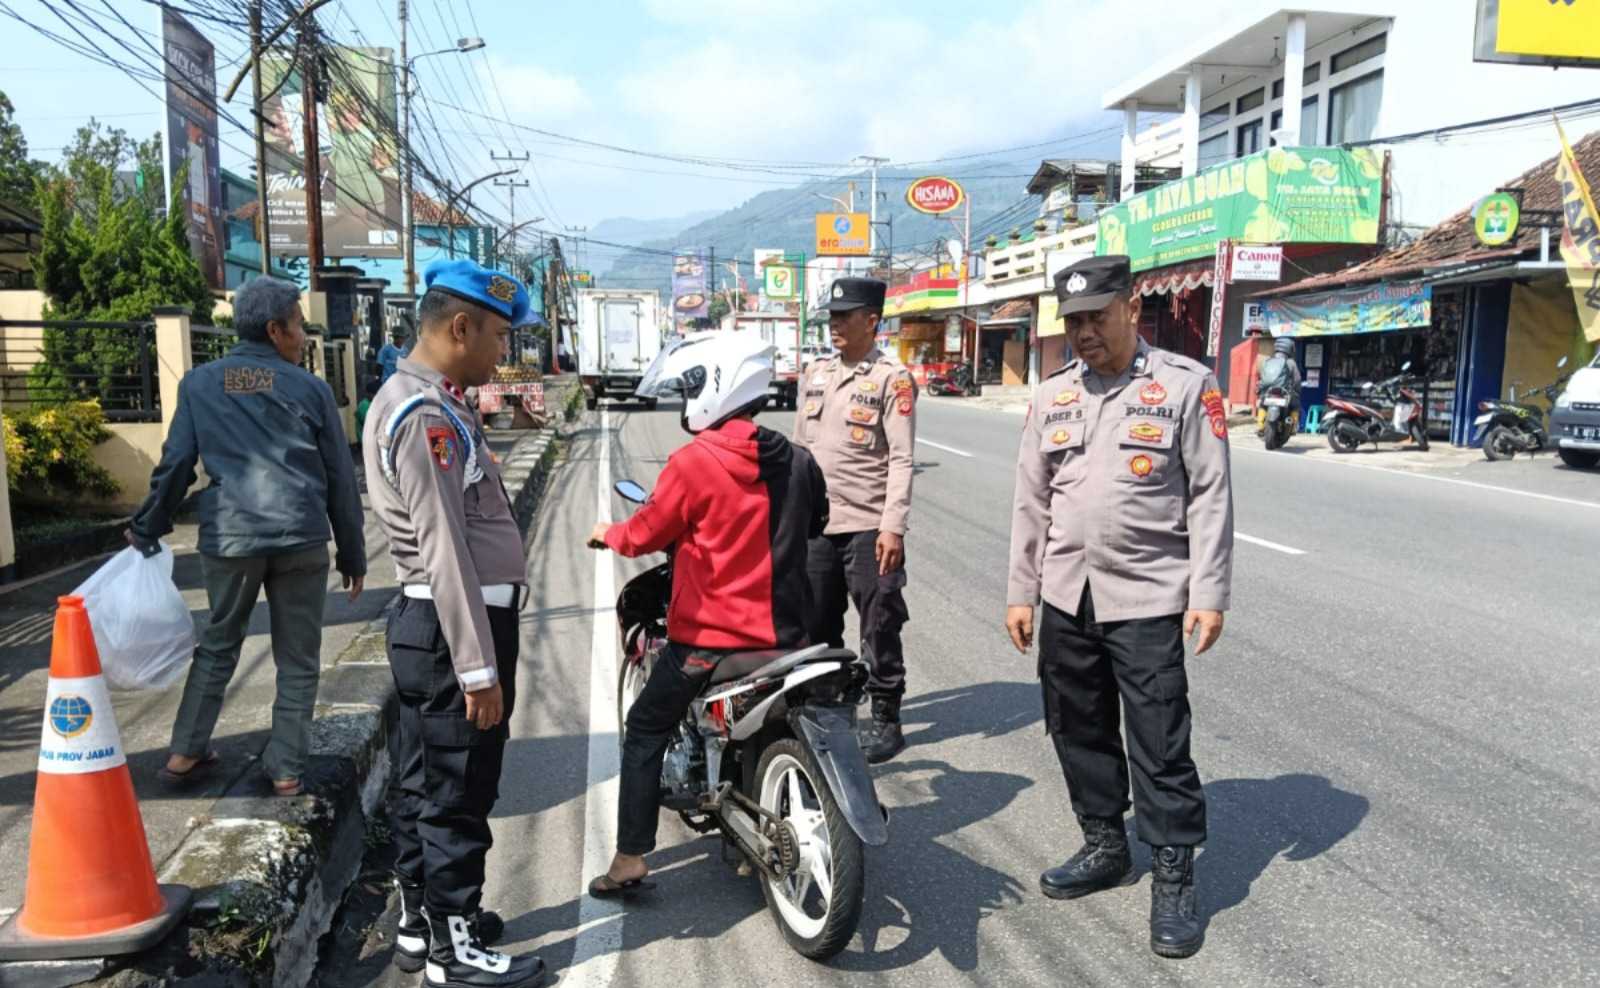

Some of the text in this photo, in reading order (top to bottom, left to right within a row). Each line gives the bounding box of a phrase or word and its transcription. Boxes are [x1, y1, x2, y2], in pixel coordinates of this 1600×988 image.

[915, 185, 955, 202] HISANA
[1237, 250, 1280, 263] Canon
[1208, 240, 1228, 355] PHOTO COPY
[1125, 406, 1173, 419] POLRI
[57, 751, 83, 761] PROV
[86, 746, 115, 760] JABAR
